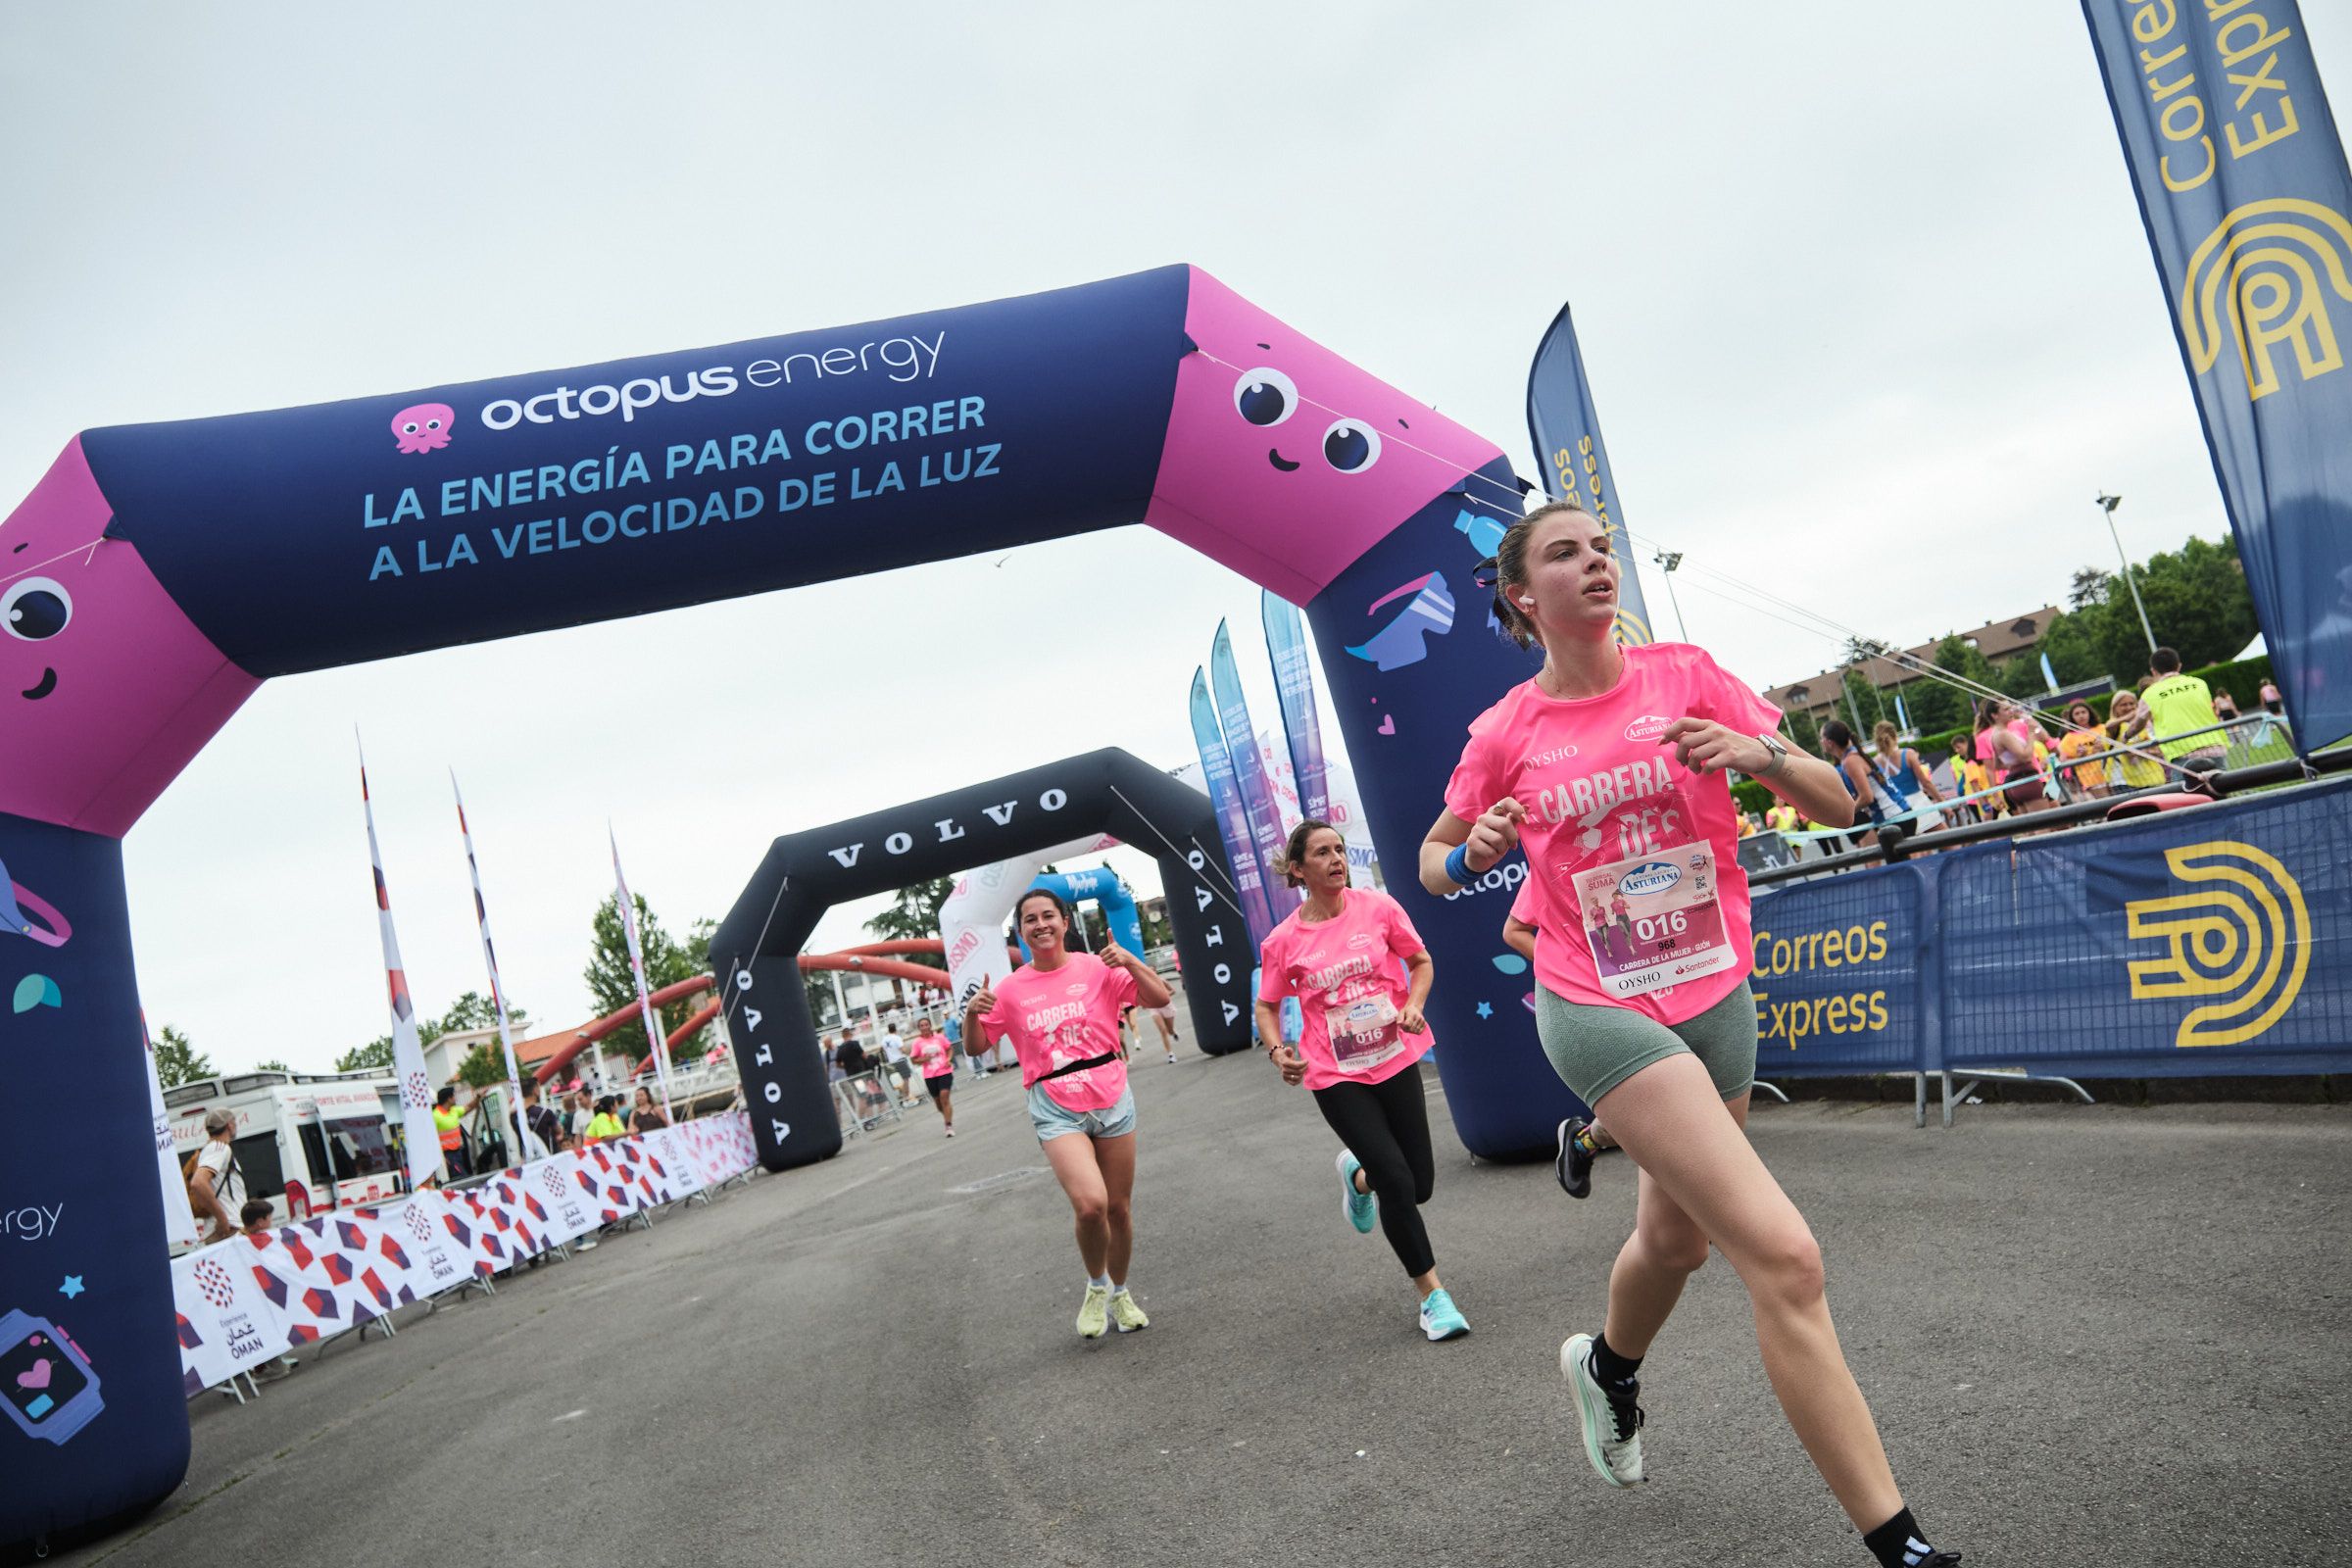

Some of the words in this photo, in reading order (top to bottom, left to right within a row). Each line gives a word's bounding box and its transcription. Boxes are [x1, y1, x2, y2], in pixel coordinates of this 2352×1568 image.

[2125, 0, 2216, 193] Corre
[480, 365, 739, 430] octopus
[746, 330, 946, 388] energy
[364, 487, 425, 529] LA
[439, 444, 651, 516] ENERGÍA
[664, 426, 791, 479] PARA
[805, 395, 986, 456] CORRER
[368, 546, 403, 581] A
[416, 533, 479, 574] LA
[491, 485, 765, 560] VELOCIDAD
[778, 471, 835, 513] DE
[850, 460, 906, 500] LA
[918, 443, 1003, 487] LUZ
[1578, 434, 1623, 578] press
[1523, 745, 1578, 772] OYSHO
[1539, 756, 1675, 824] CARRERA
[828, 787, 1068, 869] VOLVO
[1588, 878, 1615, 892] SUMA
[1625, 870, 1679, 892] ASTURIANA
[1188, 850, 1240, 1026] VOLVO
[1636, 909, 1688, 941] 016
[1619, 957, 1651, 971] CARRERA
[1652, 956, 1660, 964] DE
[1661, 953, 1670, 961] LA
[1671, 948, 1691, 959] MUJER
[1658, 939, 1676, 952] 968
[1751, 920, 1887, 978] Correos
[1306, 955, 1373, 990] CARRERA
[1618, 971, 1661, 991] OYSHO
[1685, 956, 1721, 973] Santander
[1027, 1001, 1087, 1031] CARRERA
[1752, 990, 1888, 1051] Express
[1355, 1029, 1384, 1045] 016
[736, 969, 792, 1147] VOLVO
[0, 1202, 63, 1241] rgy
[231, 1337, 264, 1360] OMAN
